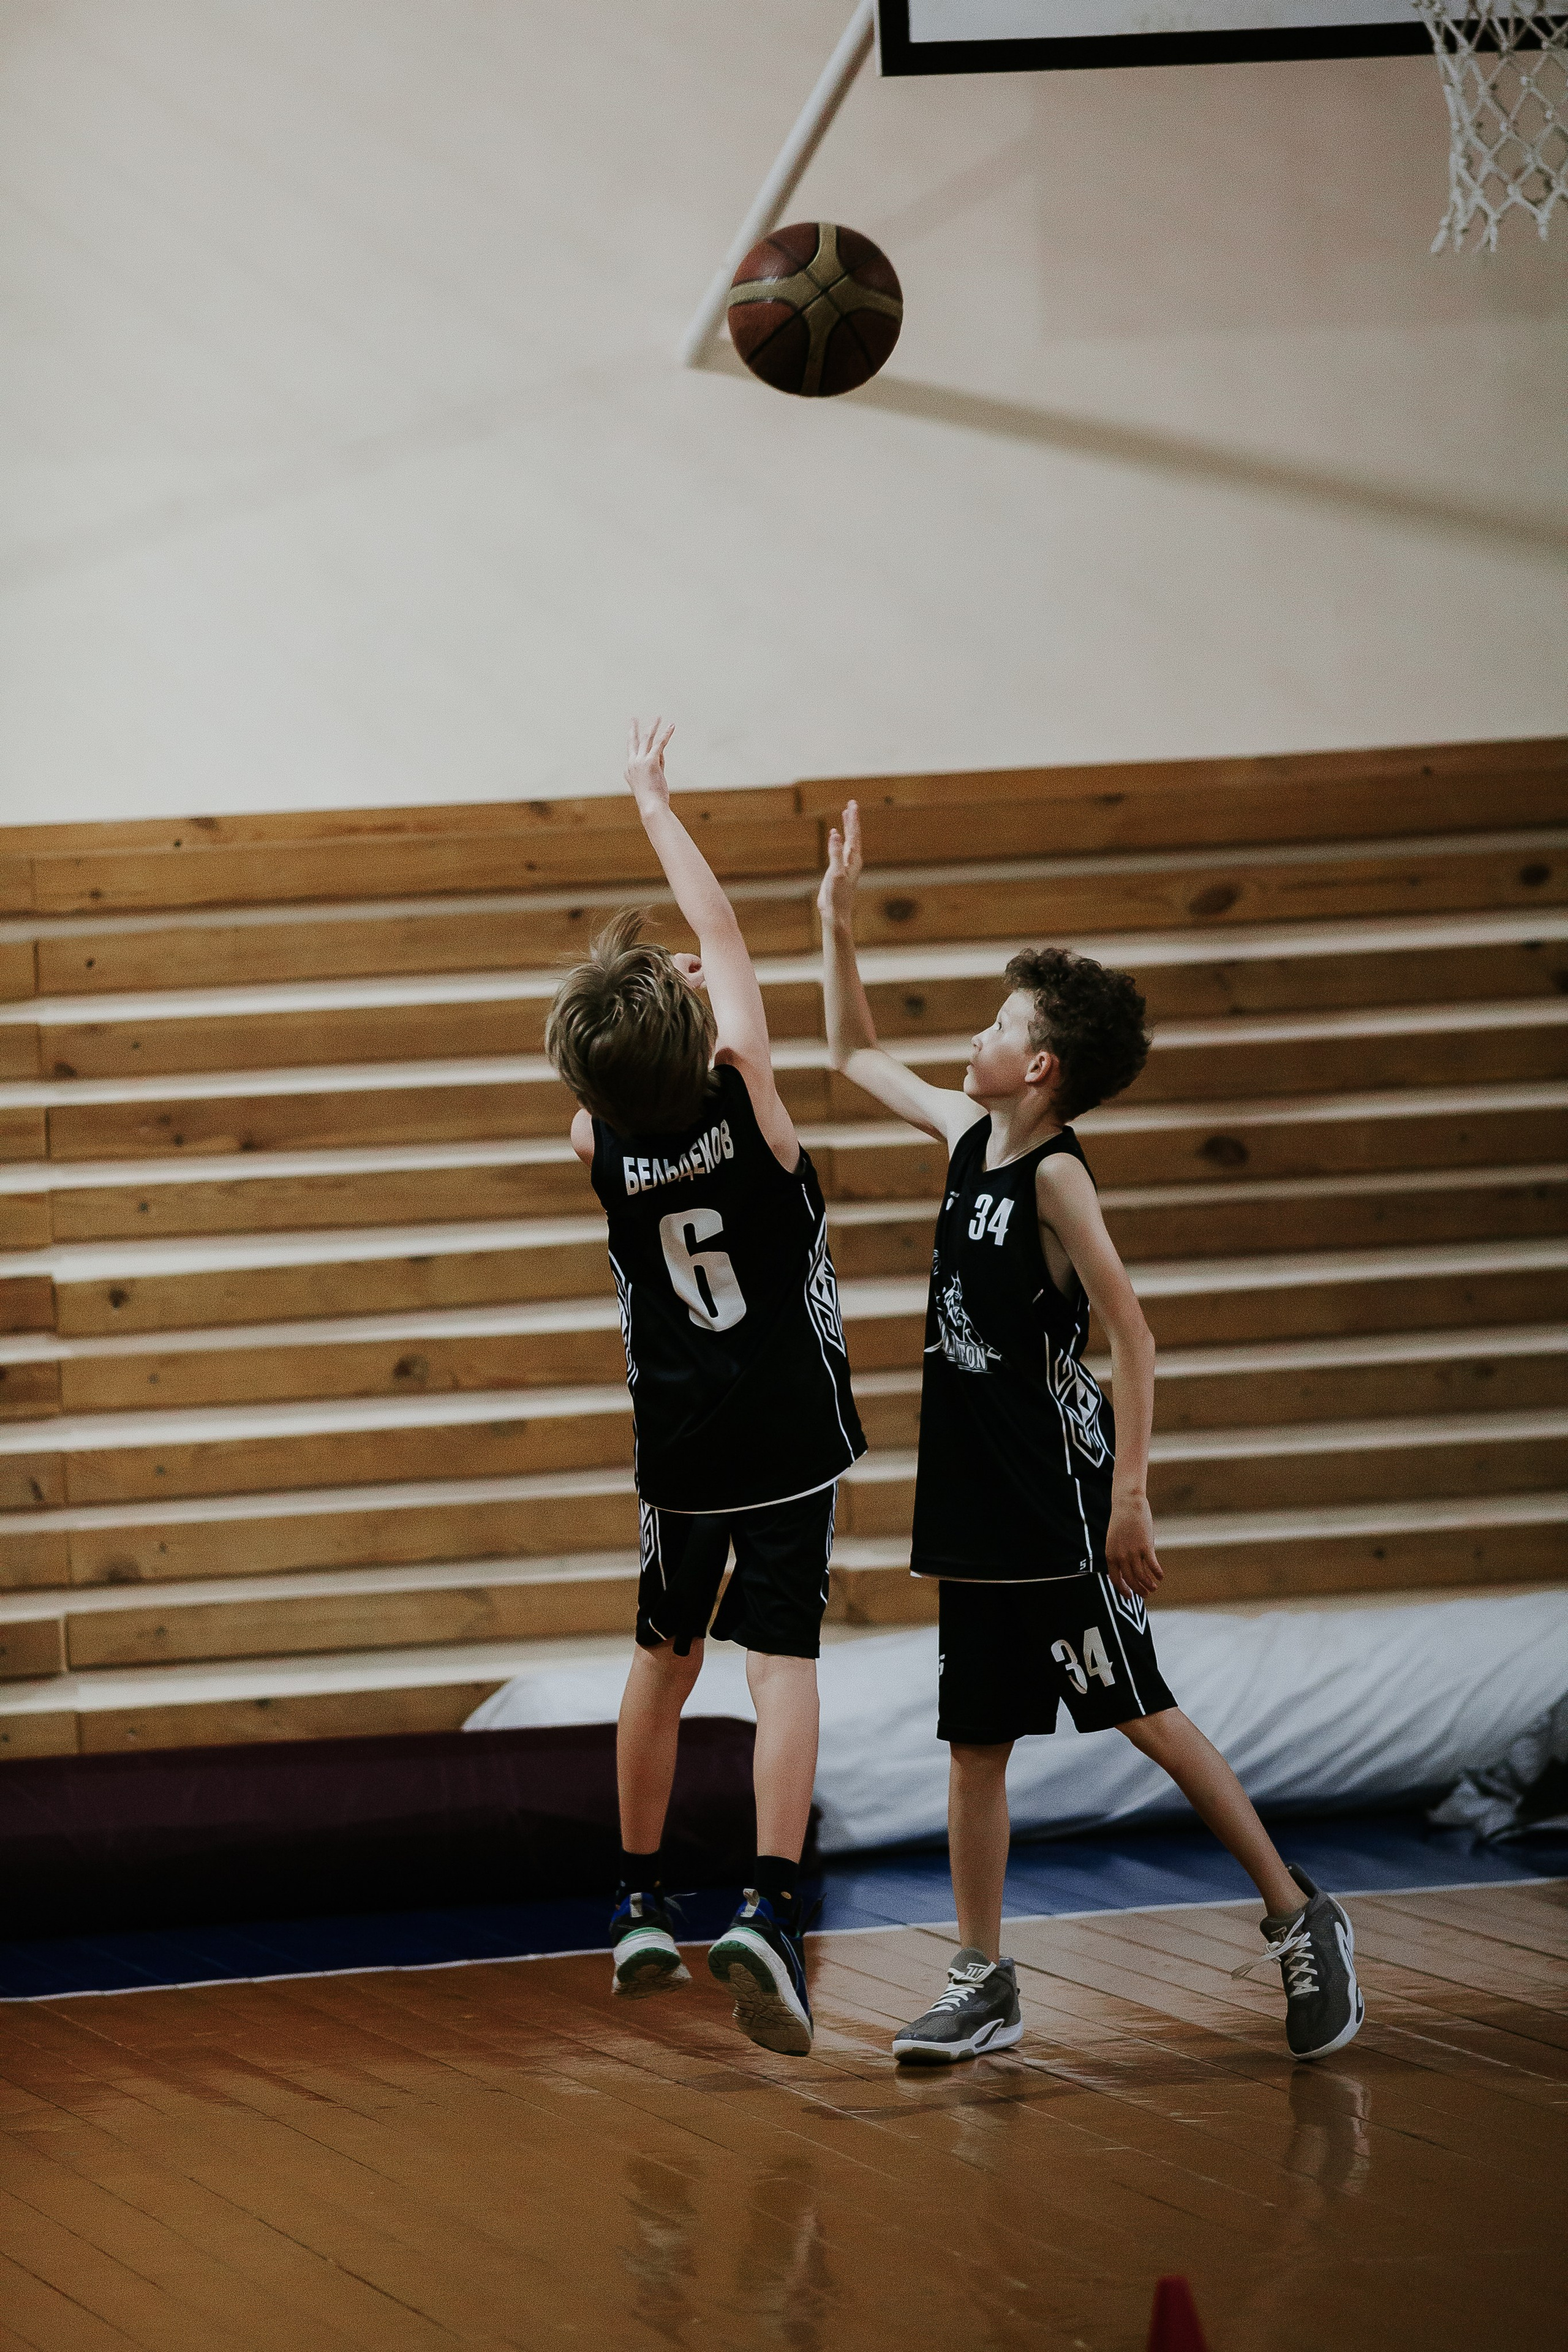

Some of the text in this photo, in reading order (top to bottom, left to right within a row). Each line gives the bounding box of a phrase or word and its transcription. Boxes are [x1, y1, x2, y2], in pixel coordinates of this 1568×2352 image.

[968, 1194, 1015, 1246] 34
[659, 1208, 747, 1332] 6
[1050, 1626, 1115, 1694] 34
